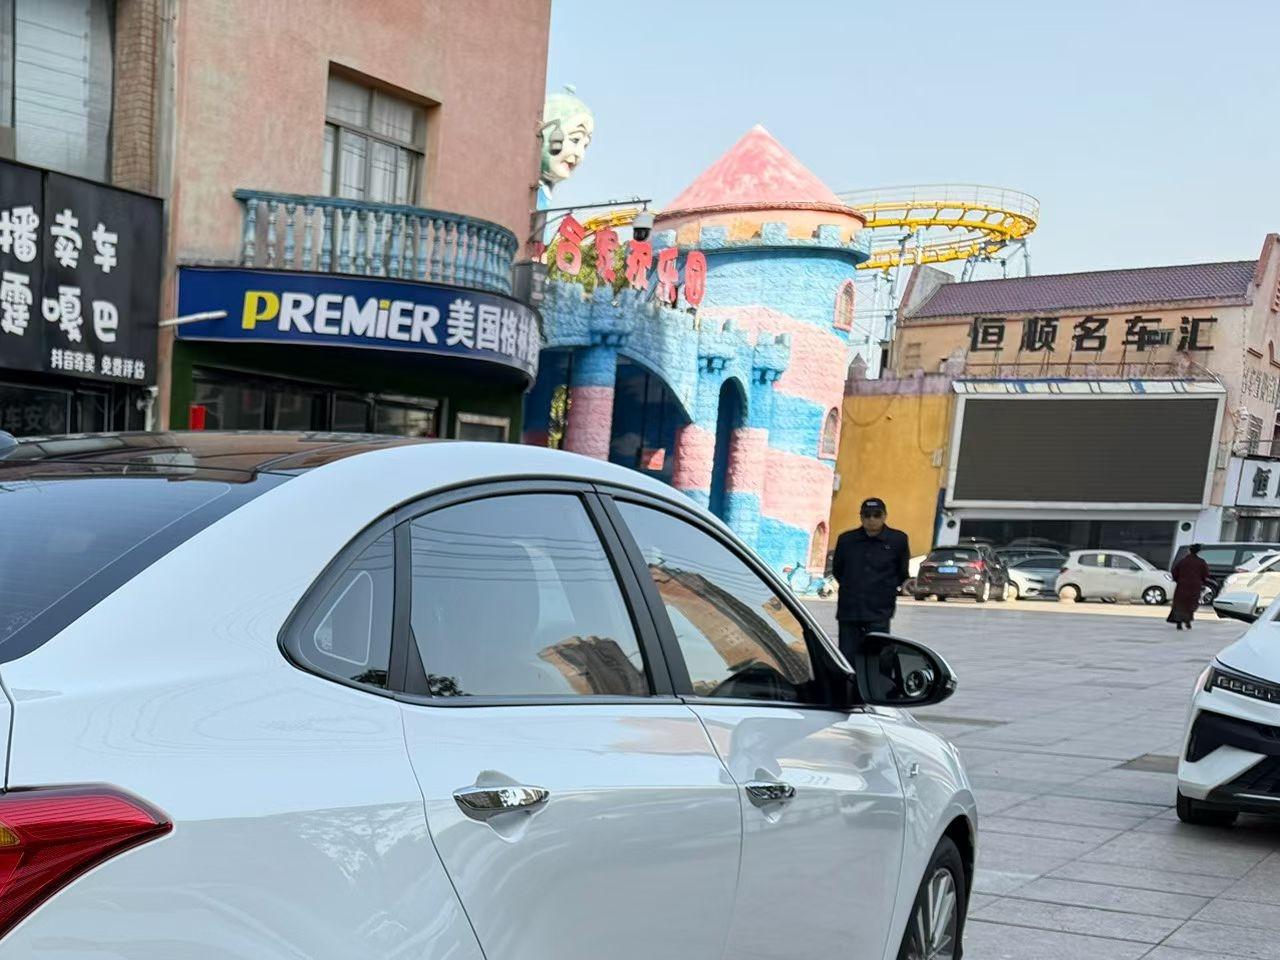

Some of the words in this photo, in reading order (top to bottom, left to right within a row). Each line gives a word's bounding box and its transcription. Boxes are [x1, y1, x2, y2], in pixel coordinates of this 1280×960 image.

[968, 315, 1218, 352] 恒顺名车汇
[101, 354, 145, 379] 免费评估
